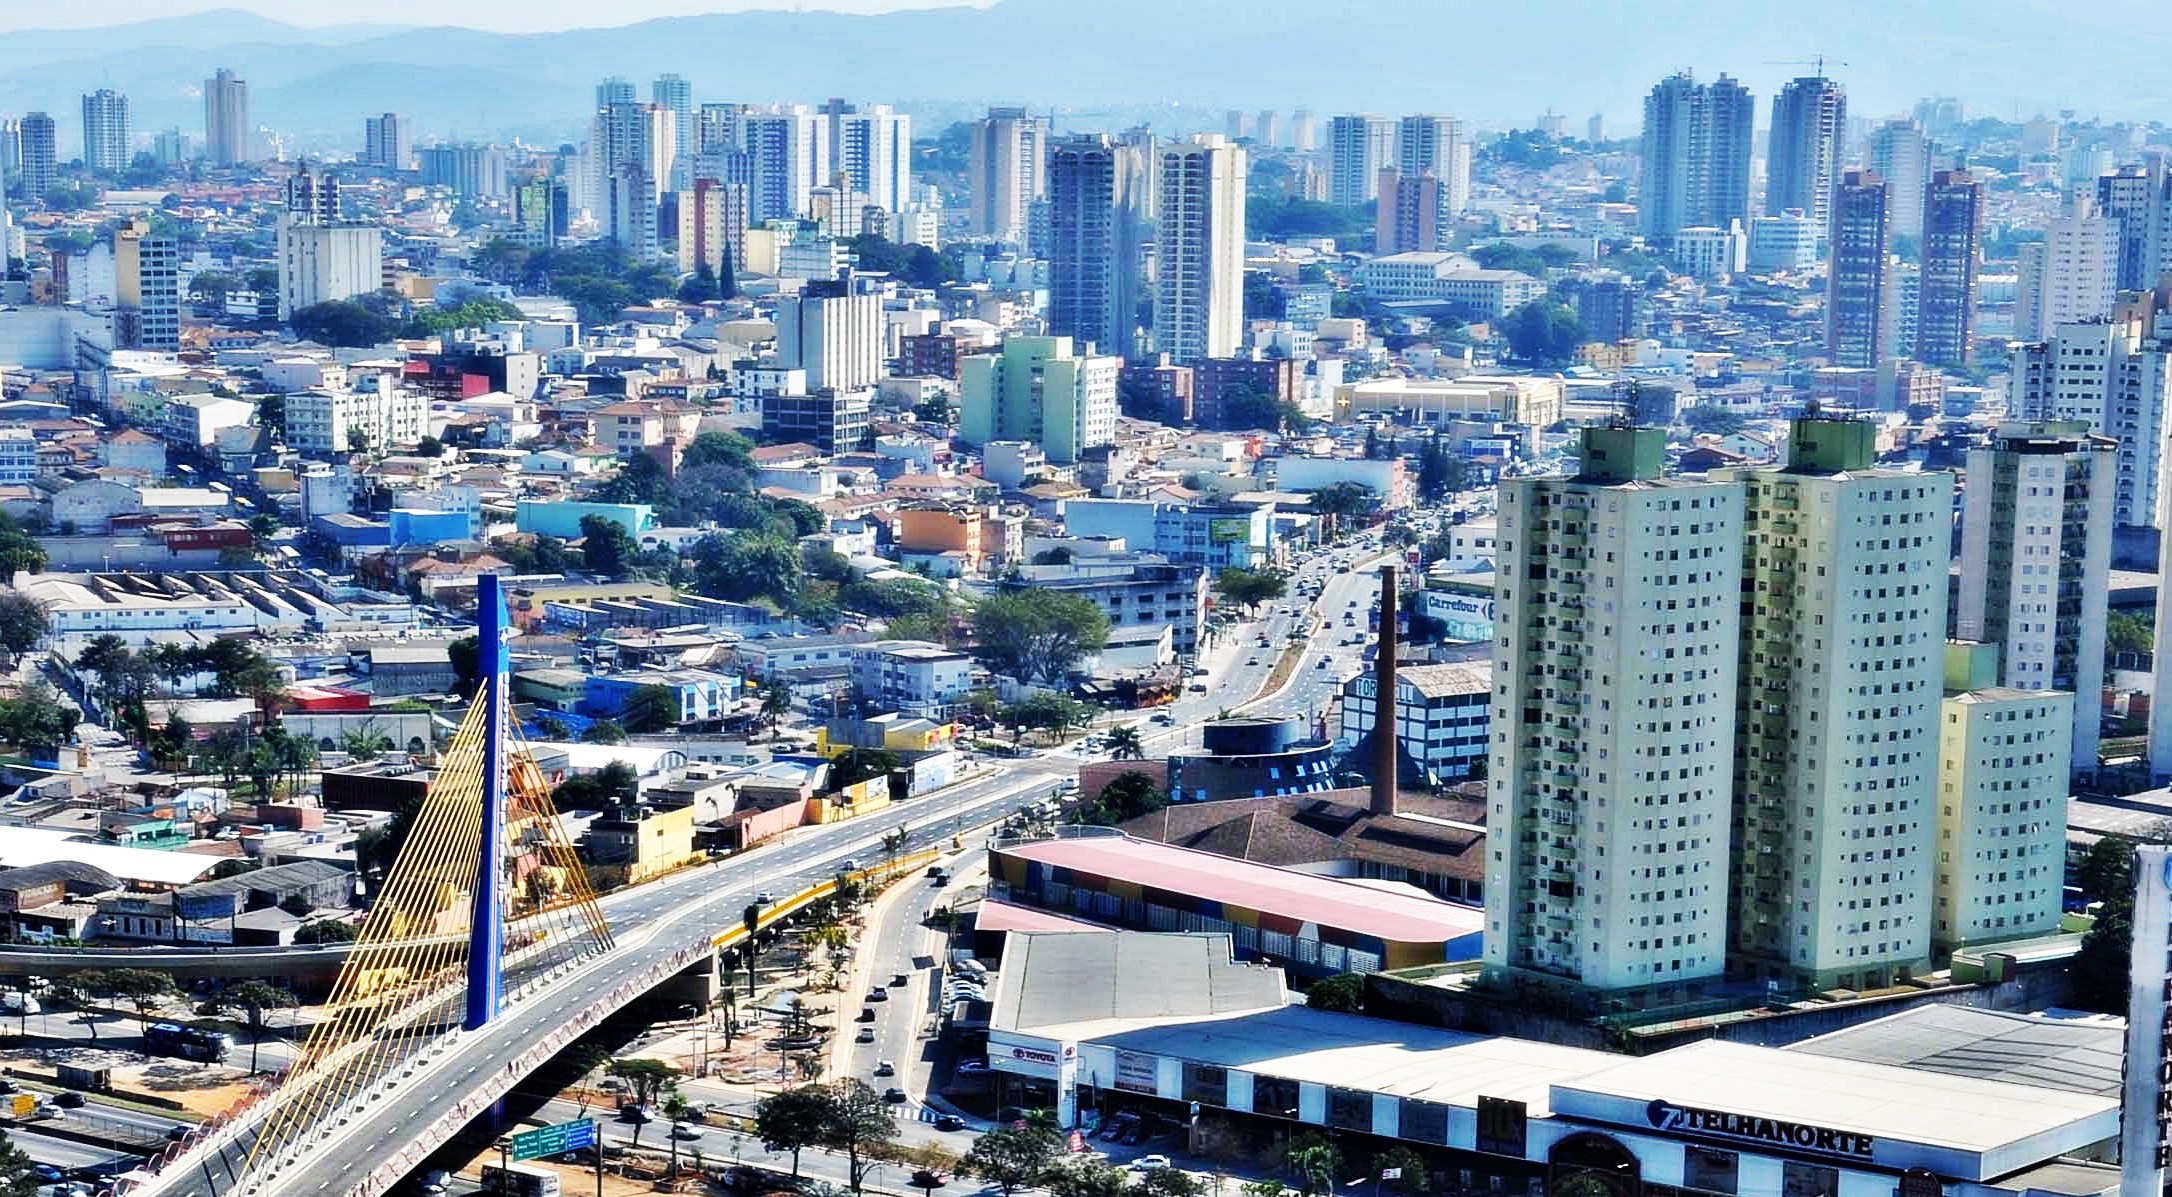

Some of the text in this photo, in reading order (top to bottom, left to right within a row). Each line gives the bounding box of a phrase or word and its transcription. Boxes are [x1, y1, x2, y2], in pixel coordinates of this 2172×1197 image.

[1430, 597, 1478, 612] Carrefour
[1025, 1051, 1056, 1063] TOYOTA
[1688, 1109, 1874, 1155] TELHANORTE
